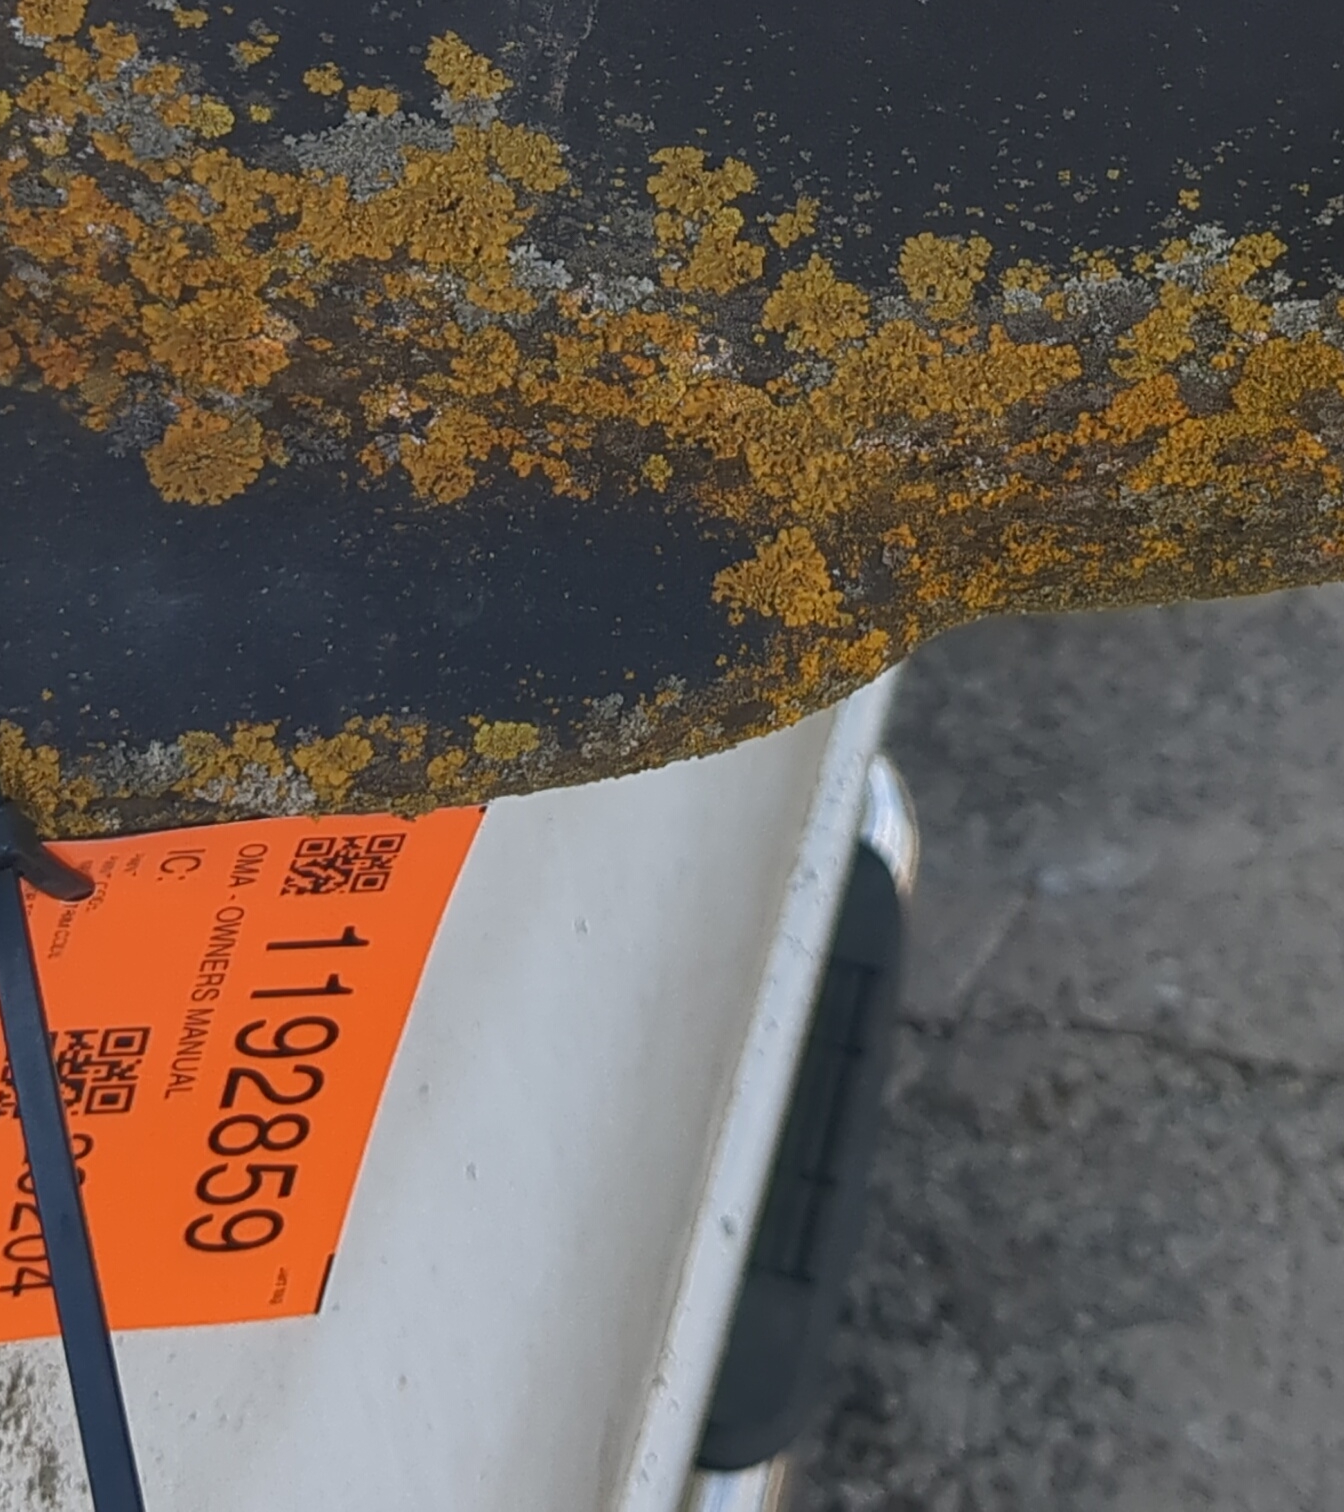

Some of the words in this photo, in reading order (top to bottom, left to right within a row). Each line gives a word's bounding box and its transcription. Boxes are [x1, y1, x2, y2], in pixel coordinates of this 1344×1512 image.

[157, 848, 206, 881] IC:
[229, 843, 269, 888] OMA
[190, 906, 245, 1002] OWNERS
[163, 1006, 215, 1100] MANUAL
[184, 924, 370, 1253] 1192859
